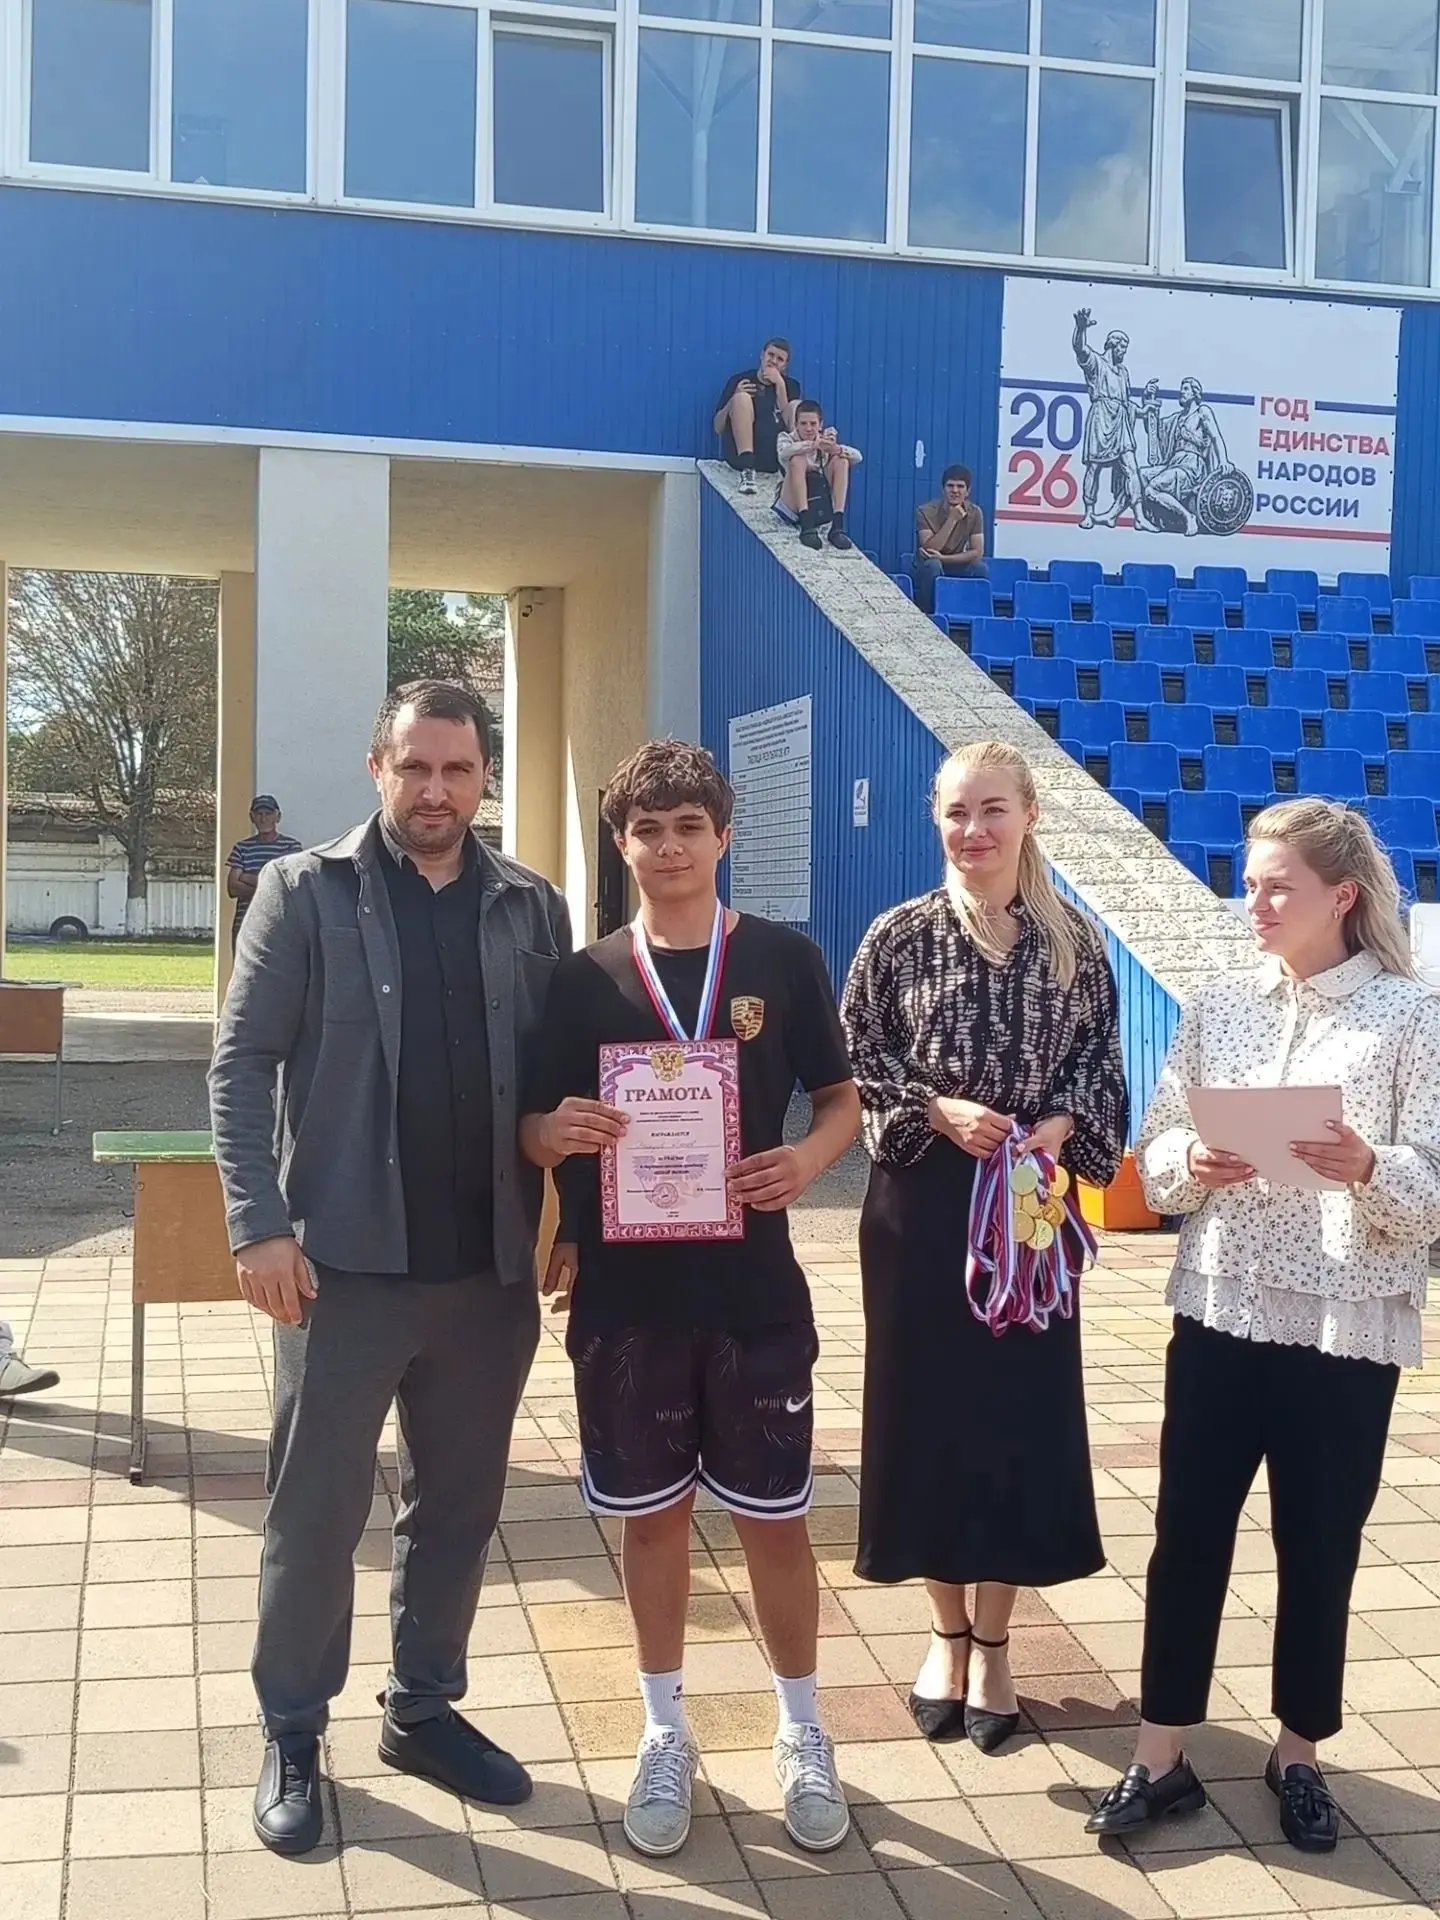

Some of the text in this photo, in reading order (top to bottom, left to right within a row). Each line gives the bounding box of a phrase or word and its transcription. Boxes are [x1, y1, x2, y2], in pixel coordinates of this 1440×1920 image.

[1011, 392, 1082, 451] 20
[1260, 396, 1309, 421] ГОД
[1259, 428, 1389, 456] ЕДИНСТВА
[1008, 450, 1077, 508] 26
[1258, 460, 1376, 487] НАРОДОВ
[1256, 493, 1359, 518] РОССИИ
[624, 1087, 713, 1102] ГРАМОТА
